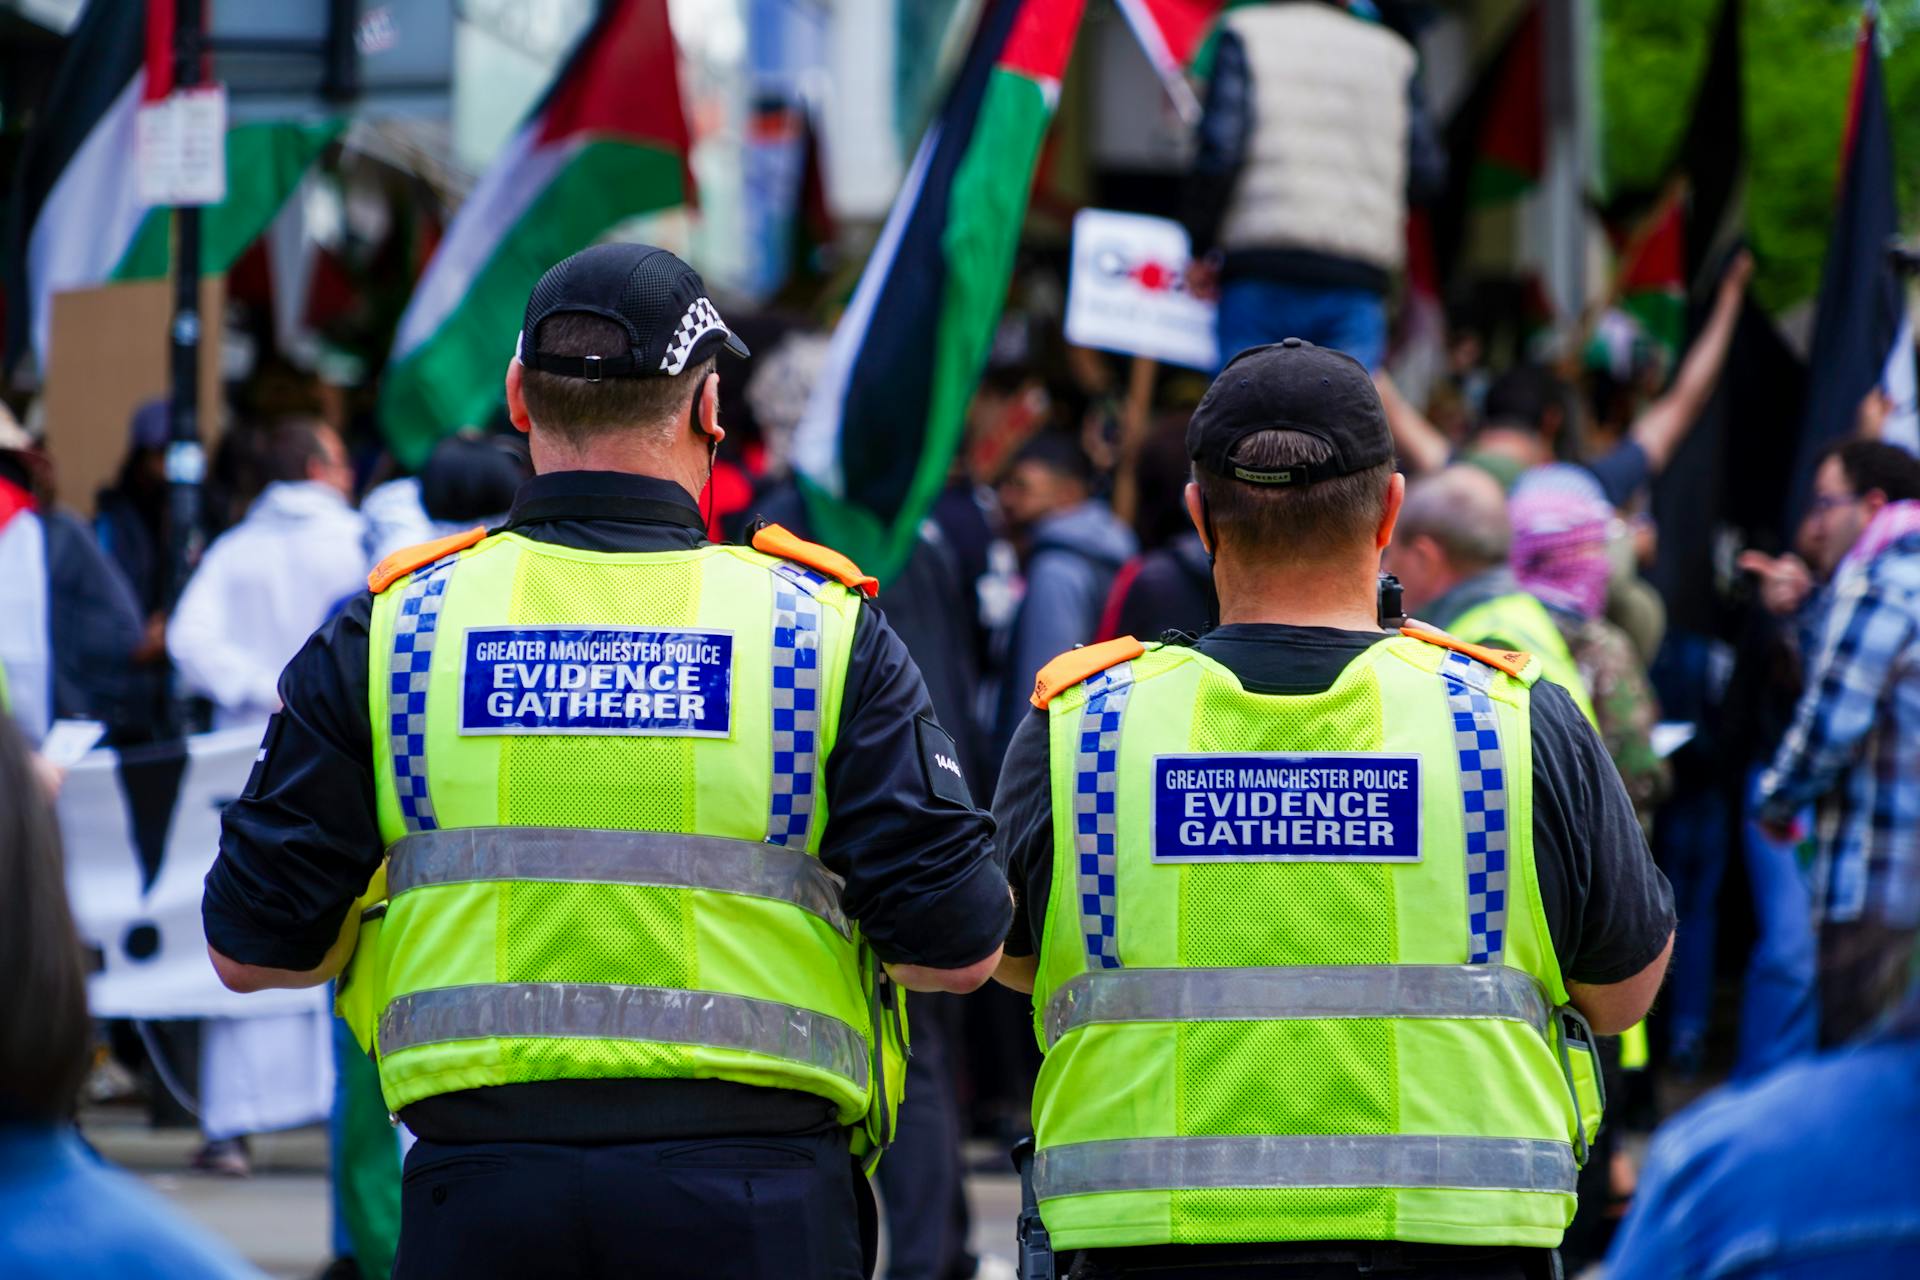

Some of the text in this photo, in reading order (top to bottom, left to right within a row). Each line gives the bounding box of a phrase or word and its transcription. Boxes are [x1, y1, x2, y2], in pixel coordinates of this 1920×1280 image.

[476, 640, 721, 665] GREATER MANCHESTER POLICE
[493, 663, 700, 691] EVIDENCE
[486, 691, 705, 720] GATHERER
[1166, 769, 1409, 790] GREATER MANCHESTER POLICE
[1184, 791, 1390, 818] EVIDENCE
[1179, 820, 1395, 846] GATHERER
